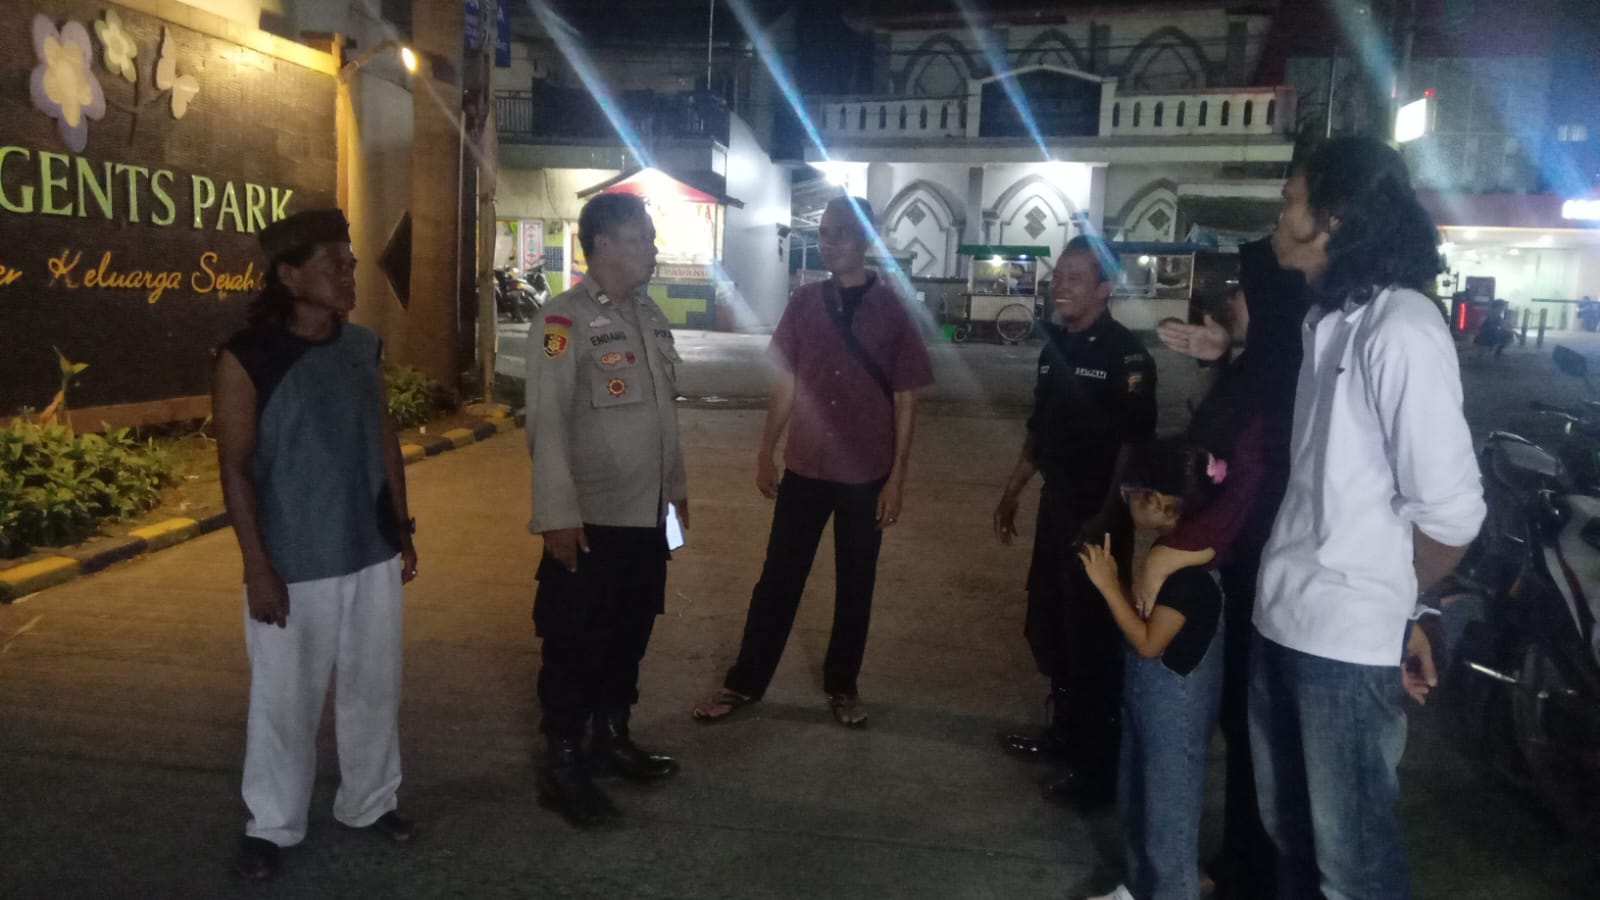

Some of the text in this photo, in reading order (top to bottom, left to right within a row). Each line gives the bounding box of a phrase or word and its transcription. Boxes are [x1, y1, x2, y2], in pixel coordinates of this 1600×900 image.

[0, 145, 294, 233] GENTS PARK
[48, 248, 181, 304] Keluarga
